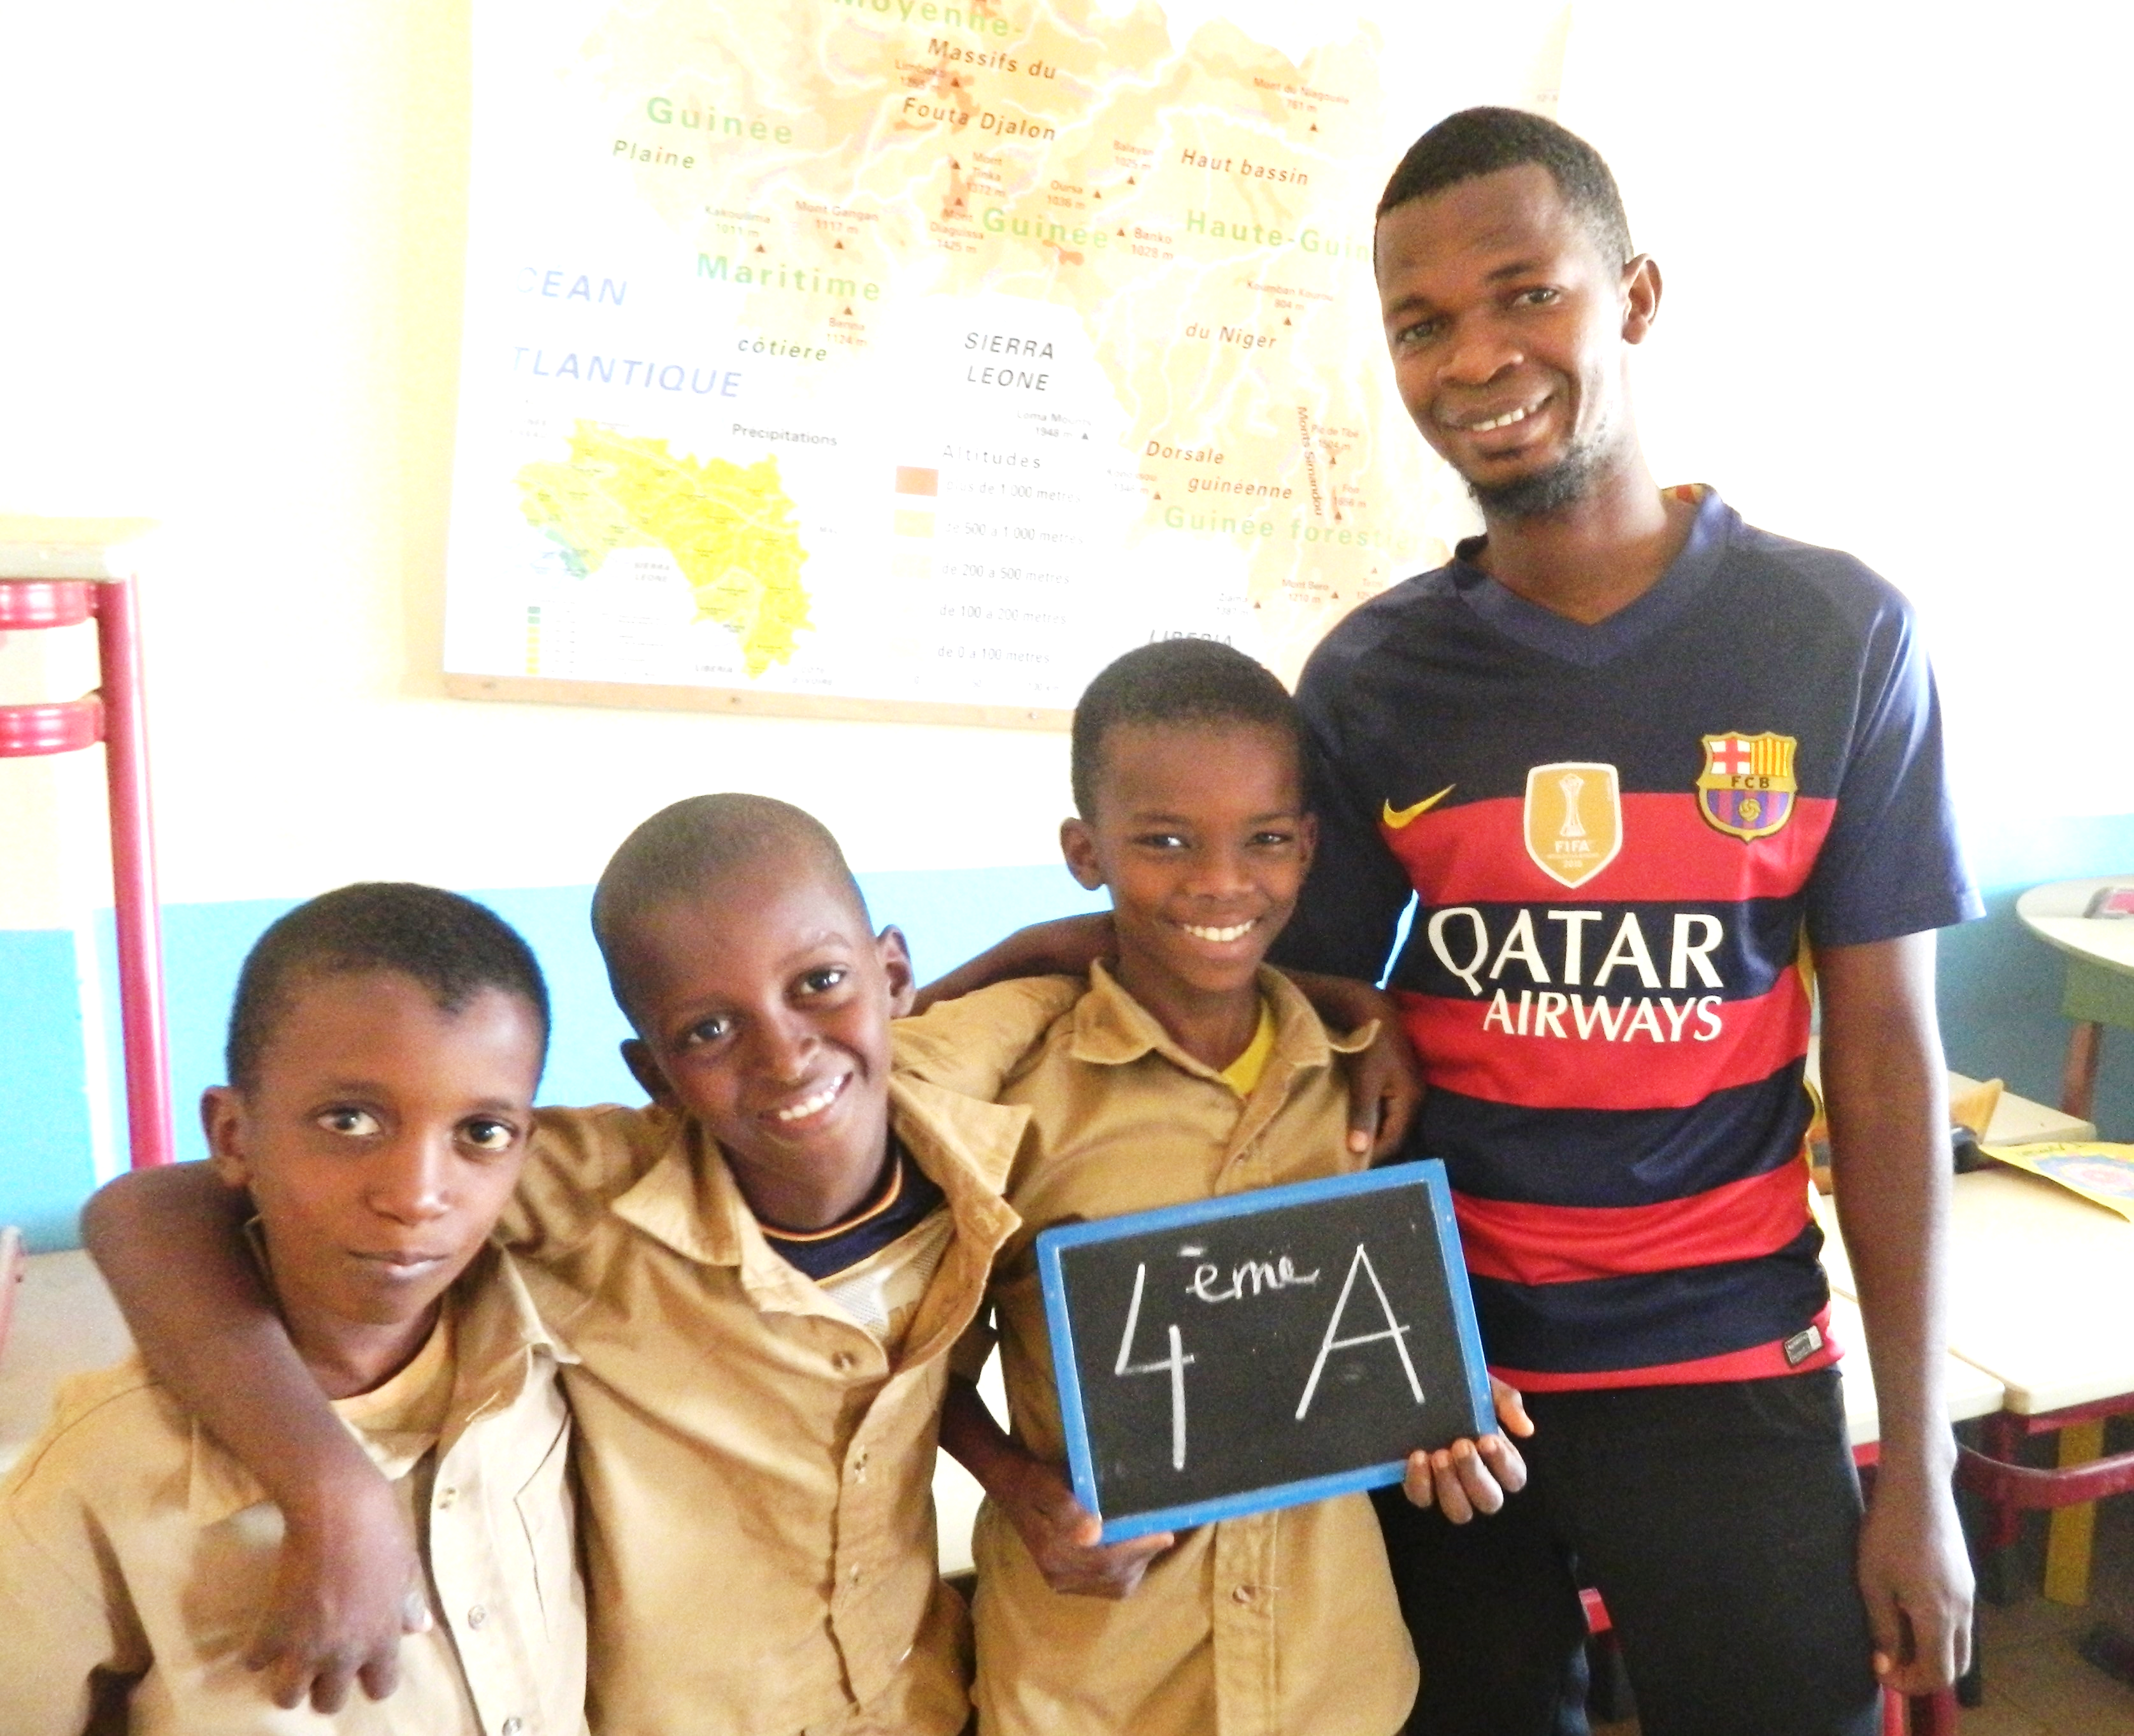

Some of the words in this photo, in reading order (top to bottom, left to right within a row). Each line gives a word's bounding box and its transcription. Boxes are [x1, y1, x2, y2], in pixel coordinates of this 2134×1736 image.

[927, 38, 1018, 73] Massifs
[1028, 59, 1057, 80] du
[902, 96, 970, 126] Fouta
[980, 111, 1057, 142] Djalon
[612, 140, 695, 170] Plaine
[1181, 147, 1233, 173] Haut
[1241, 158, 1308, 186] bassin
[1185, 209, 1371, 262] Haute-Guin
[515, 264, 627, 306] CÉAN
[696, 252, 880, 301] Maritime
[964, 331, 1054, 361] SIERRA
[1185, 322, 1210, 340] du
[1219, 325, 1277, 350] Niger
[513, 345, 743, 398] TLANTIQUE
[966, 365, 1050, 391] LEONE
[942, 444, 1041, 470] Altitudes
[1145, 440, 1225, 465] Dorsale
[947, 479, 974, 492] plus
[979, 482, 995, 494] de
[945, 522, 959, 533] de
[965, 522, 986, 536] 500
[942, 563, 957, 575] de
[963, 564, 984, 577] 200
[1000, 567, 1022, 580] 500
[940, 604, 955, 617] de
[961, 605, 982, 619] 100
[998, 608, 1019, 621] 200
[938, 645, 953, 657] de
[957, 645, 965, 658] 0
[982, 647, 1002, 661] 100
[1731, 775, 1770, 789] FCB
[1554, 840, 1591, 854] FIFA
[1428, 907, 1724, 997] QATAR
[1482, 988, 1723, 1044] AIRWAYS
[1294, 1242, 1426, 1421] A
